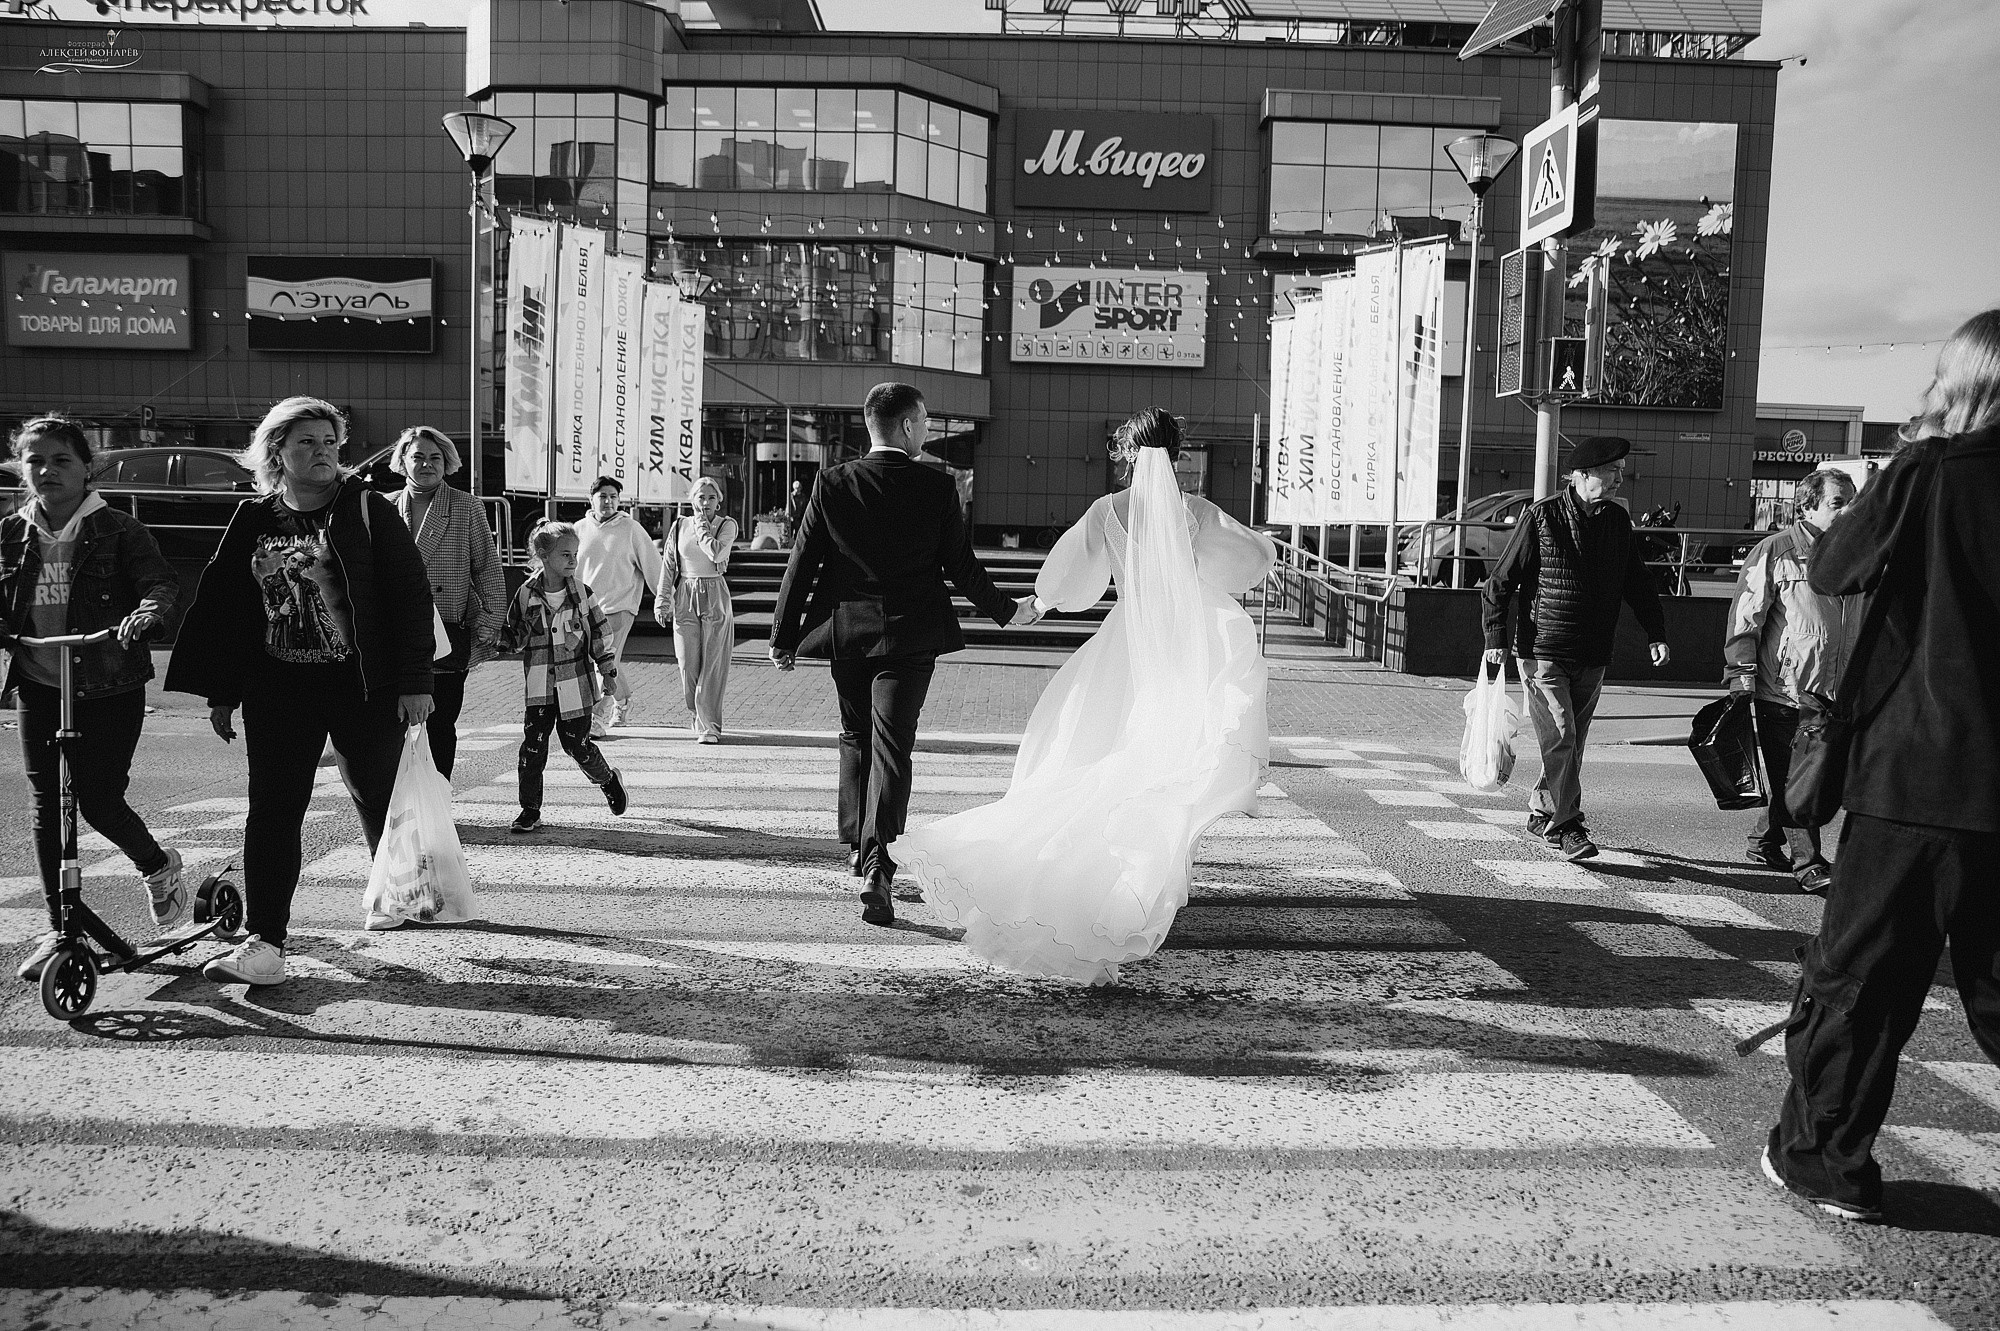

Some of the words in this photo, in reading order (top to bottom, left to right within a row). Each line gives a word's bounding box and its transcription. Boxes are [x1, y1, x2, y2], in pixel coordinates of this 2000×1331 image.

[41, 270, 178, 303] Галамарт
[578, 247, 588, 297] БЕЛЬЯ
[617, 276, 628, 328] КОЖИ
[1096, 280, 1183, 308] INTER
[1370, 275, 1380, 324] БЕЛЬЯ
[19, 315, 82, 333] ТОВАРЫ
[89, 316, 121, 335] ДЛЯ
[127, 317, 177, 336] ДОМА
[1094, 307, 1183, 331] SPORT
[573, 300, 587, 411] ПОСТЕЛЬНОГО
[1184, 352, 1201, 360] этаж
[145, 407, 152, 426] P
[615, 329, 627, 479] ВОССТАНОВЛЕНИЕ
[572, 414, 583, 474] СТИРКА
[1331, 352, 1343, 500] ВОССТАНОВЛЕНИЕ
[1785, 439, 1804, 448] KING
[1366, 441, 1376, 500] СТИРКА
[1758, 451, 1834, 462] РЕСТОРАН
